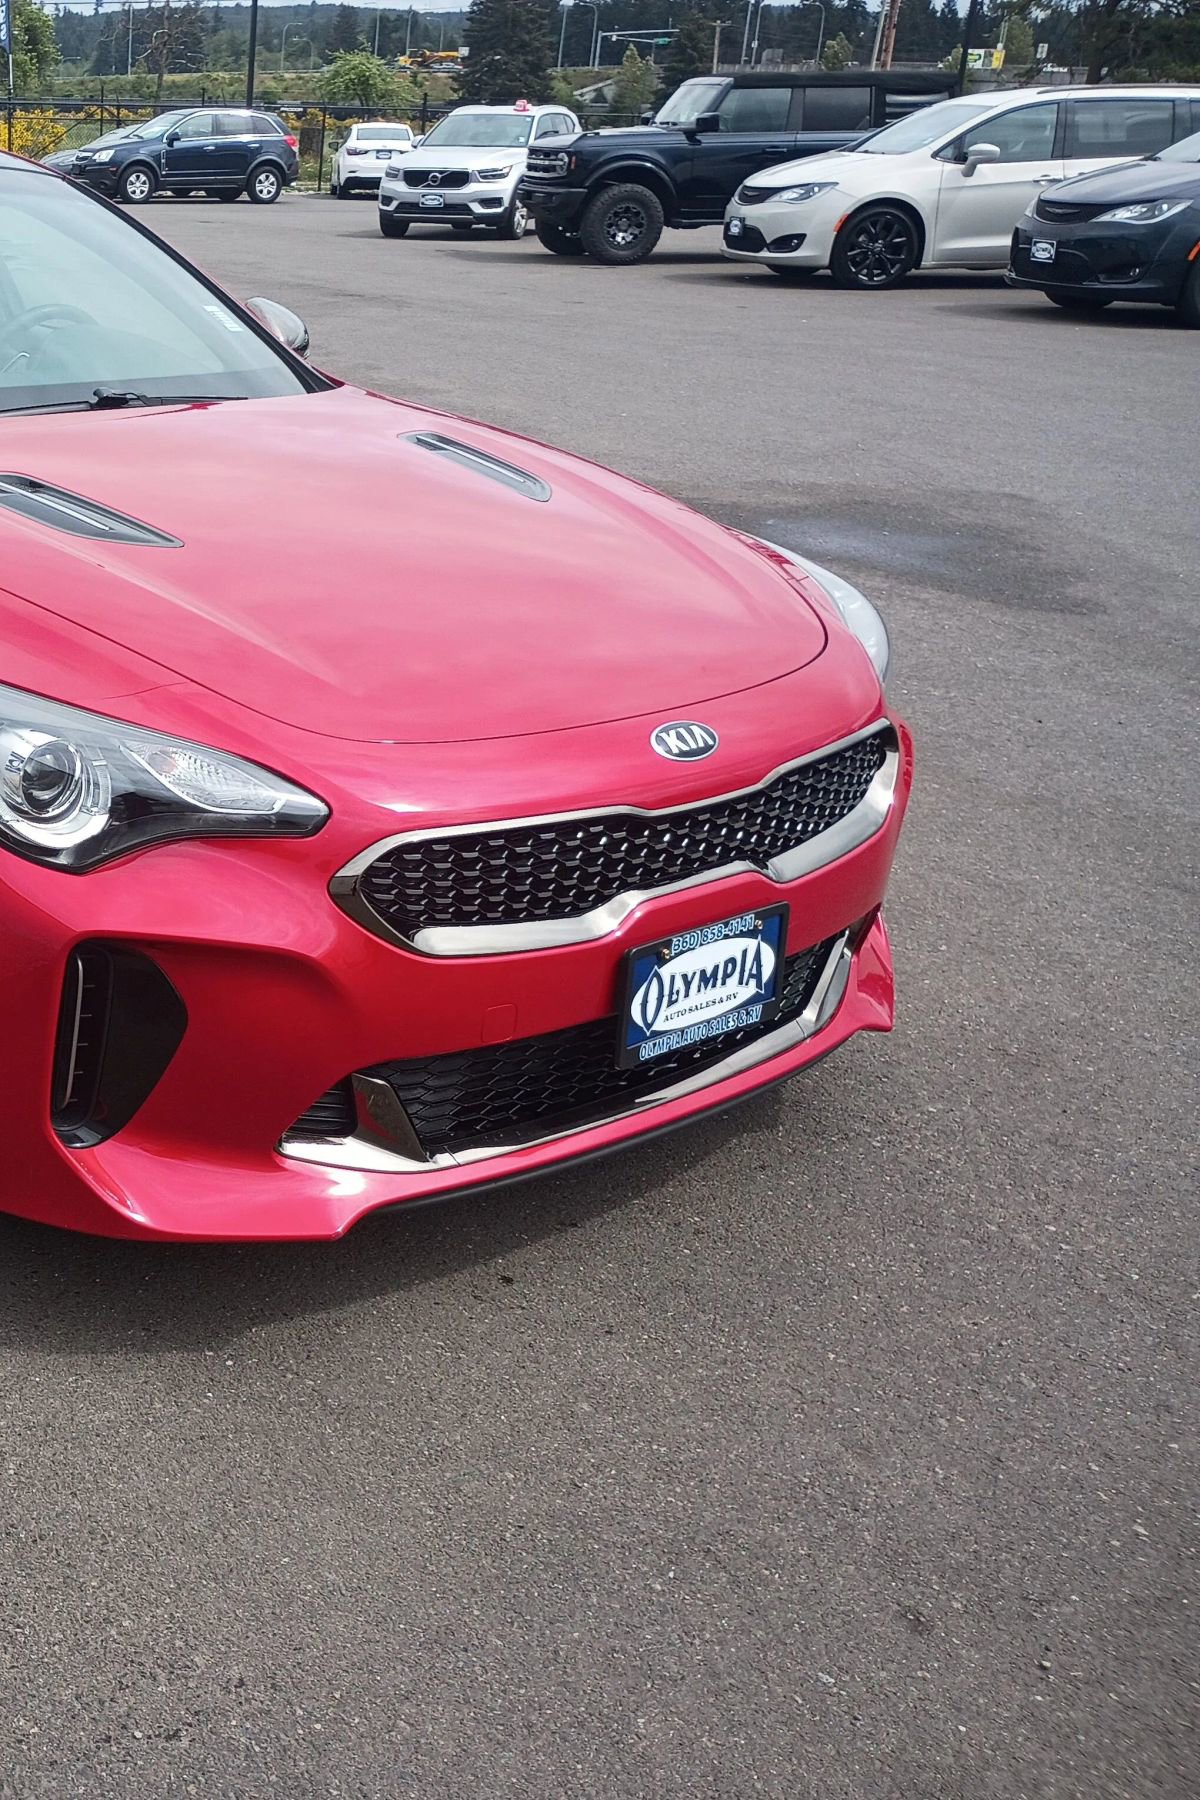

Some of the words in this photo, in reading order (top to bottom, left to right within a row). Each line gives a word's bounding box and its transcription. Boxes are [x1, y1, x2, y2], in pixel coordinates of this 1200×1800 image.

[659, 725, 714, 755] KIA
[671, 931, 699, 956] (360)
[702, 914, 755, 945] 858-4141
[640, 933, 765, 1037] OLYMPIA
[663, 1009, 687, 1023] AUTO
[687, 998, 717, 1014] SALES
[717, 996, 726, 1005] &
[726, 992, 739, 1002] RV
[639, 1032, 682, 1061] OLYMPIA
[682, 1023, 708, 1046] AUTO
[708, 1014, 737, 1039] SALES
[738, 1011, 747, 1026] &
[747, 1005, 762, 1022] RV
